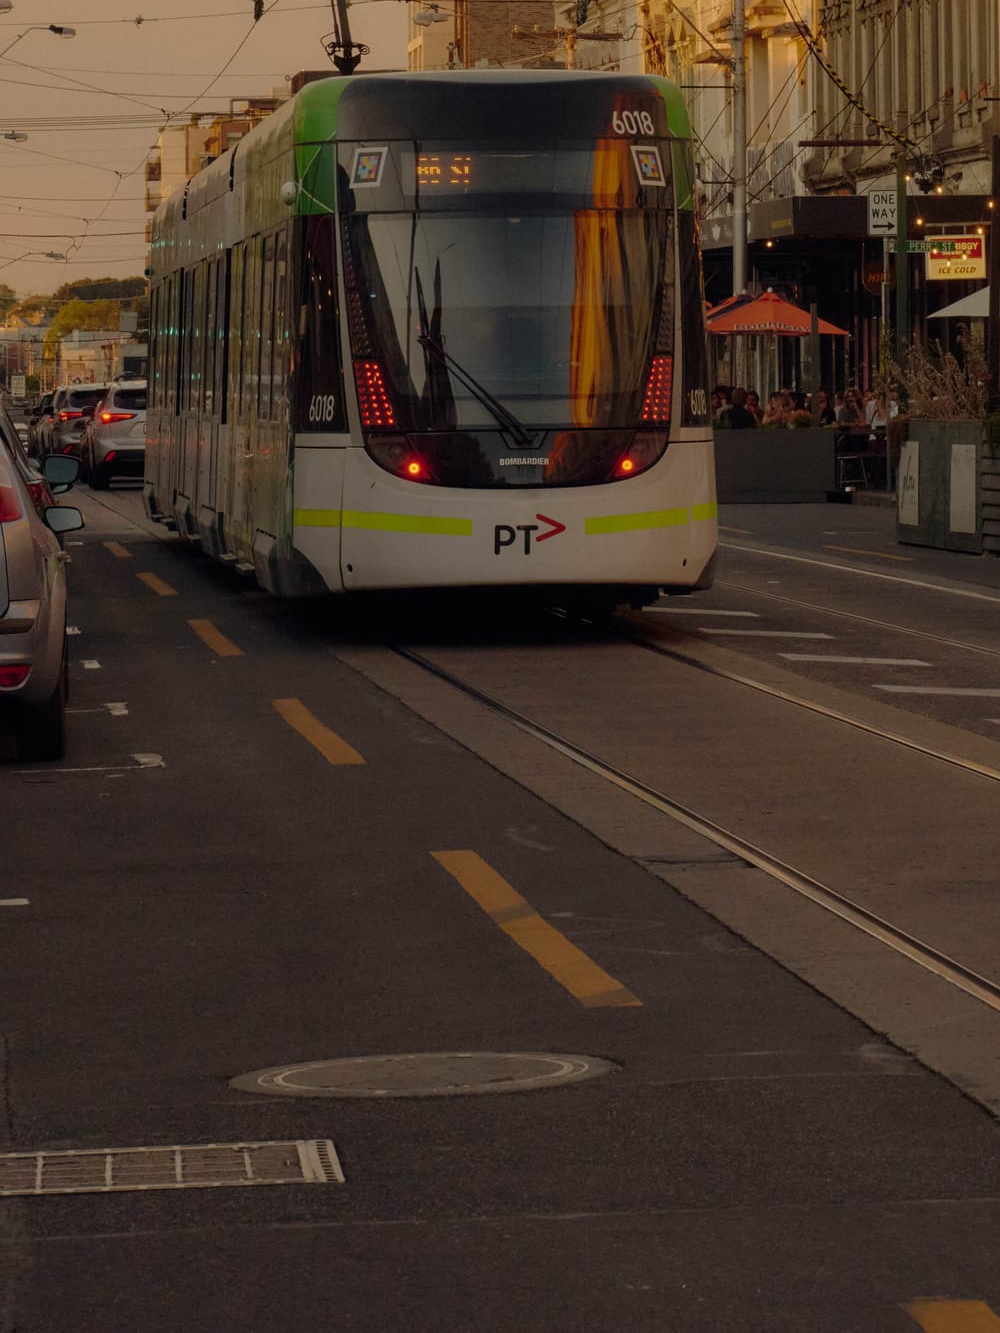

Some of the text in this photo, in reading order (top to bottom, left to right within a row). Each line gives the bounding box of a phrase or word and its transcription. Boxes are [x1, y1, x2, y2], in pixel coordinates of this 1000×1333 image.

[613, 110, 655, 136] 6018
[873, 194, 895, 205] ONE
[871, 208, 897, 219] WAY
[941, 242, 952, 252] ST
[954, 266, 976, 274] COLD
[309, 394, 335, 422] 6018
[499, 457, 551, 466] BOMBARDIER
